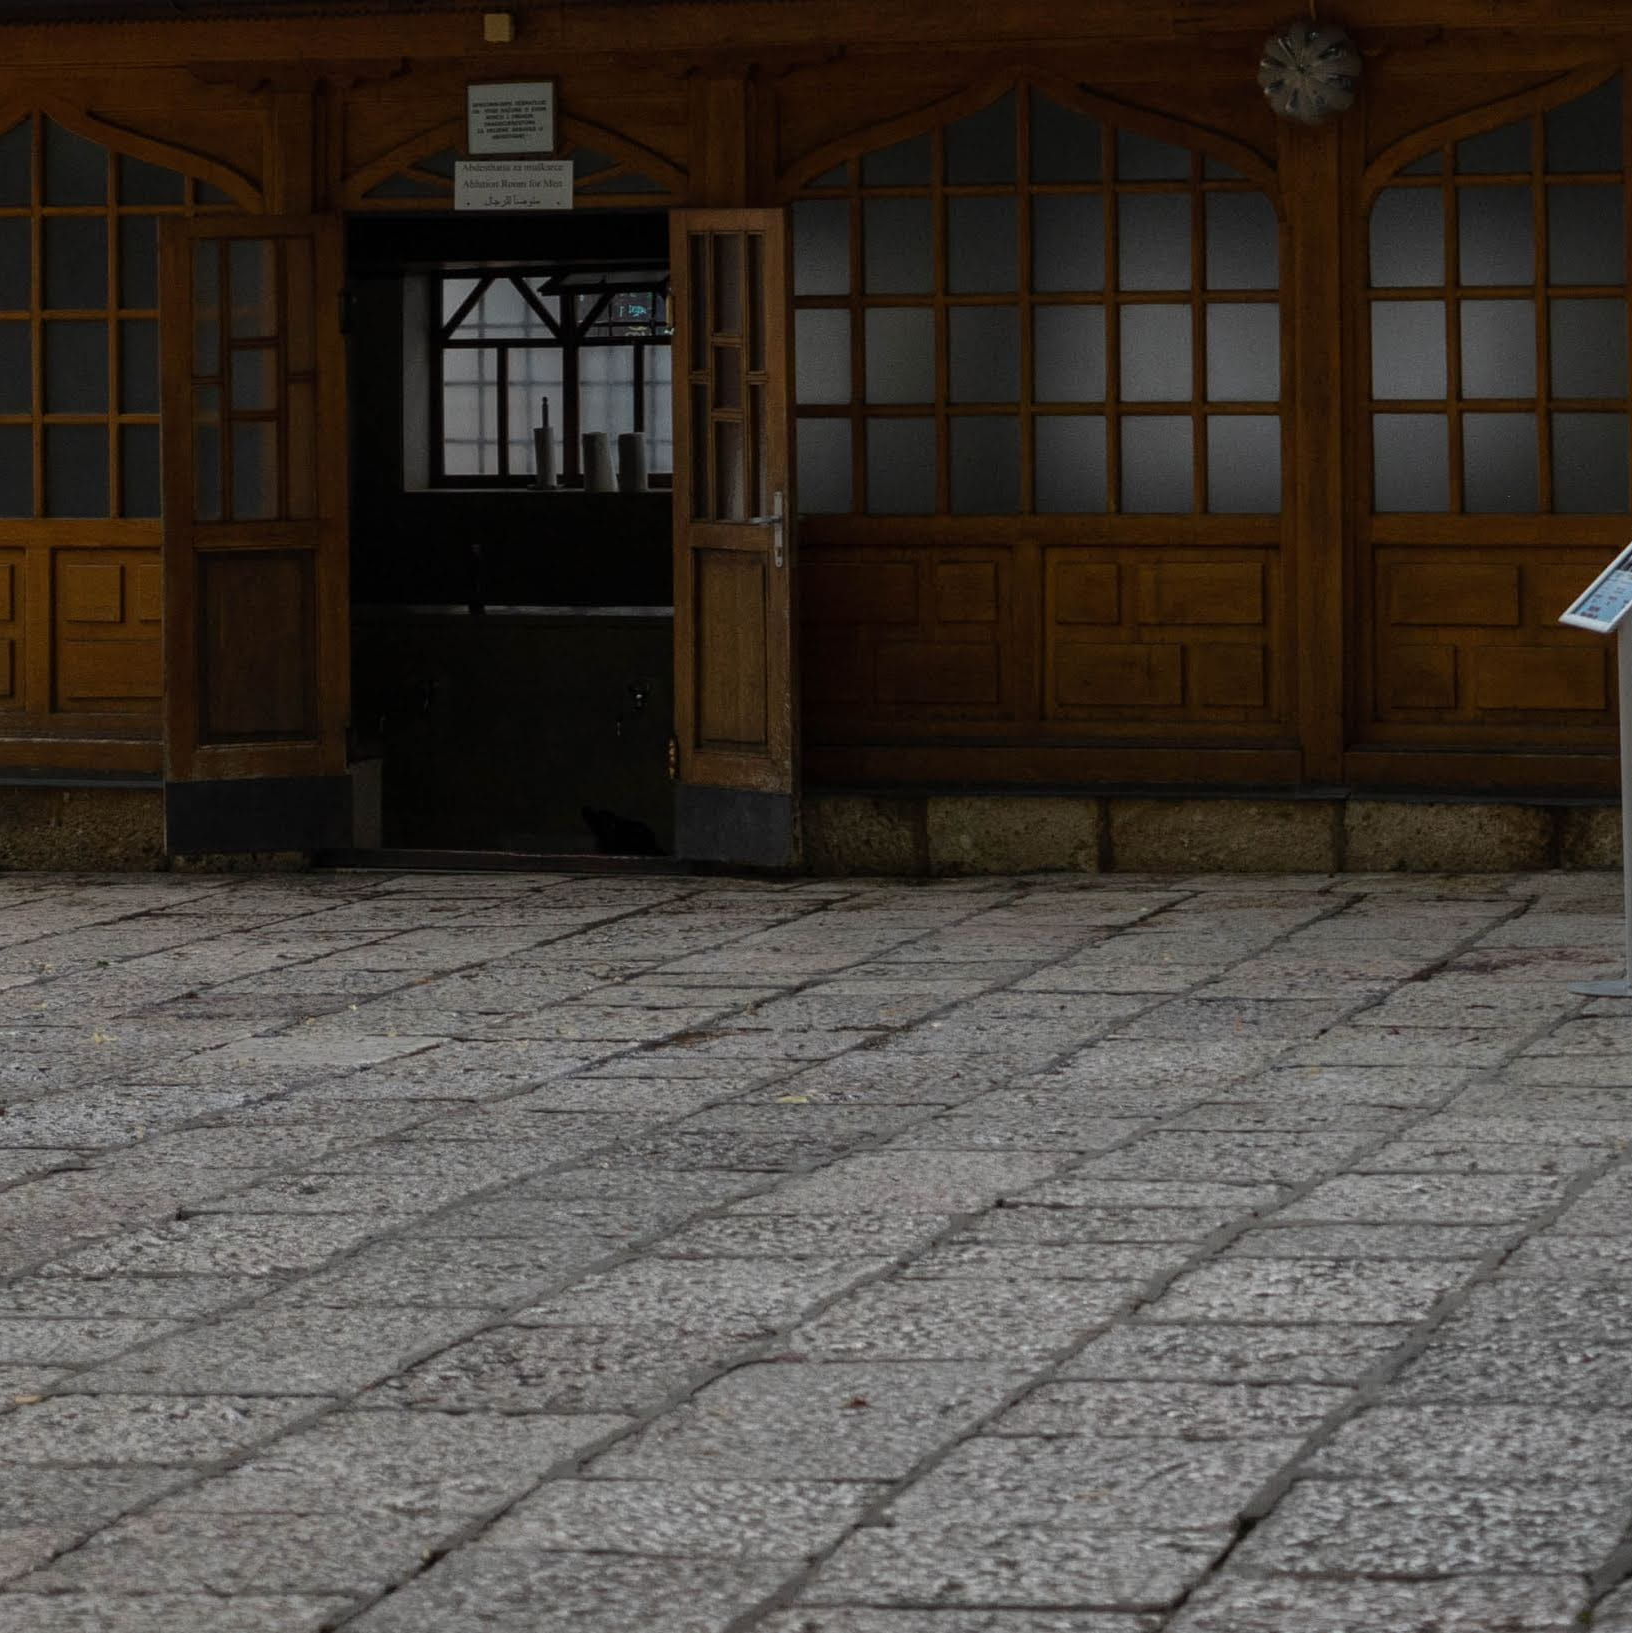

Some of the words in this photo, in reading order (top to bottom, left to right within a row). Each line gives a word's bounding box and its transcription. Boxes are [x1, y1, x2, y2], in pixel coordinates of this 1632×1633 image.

[501, 179, 527, 188] Room
[529, 179, 541, 188] for
[543, 179, 563, 188] Men
